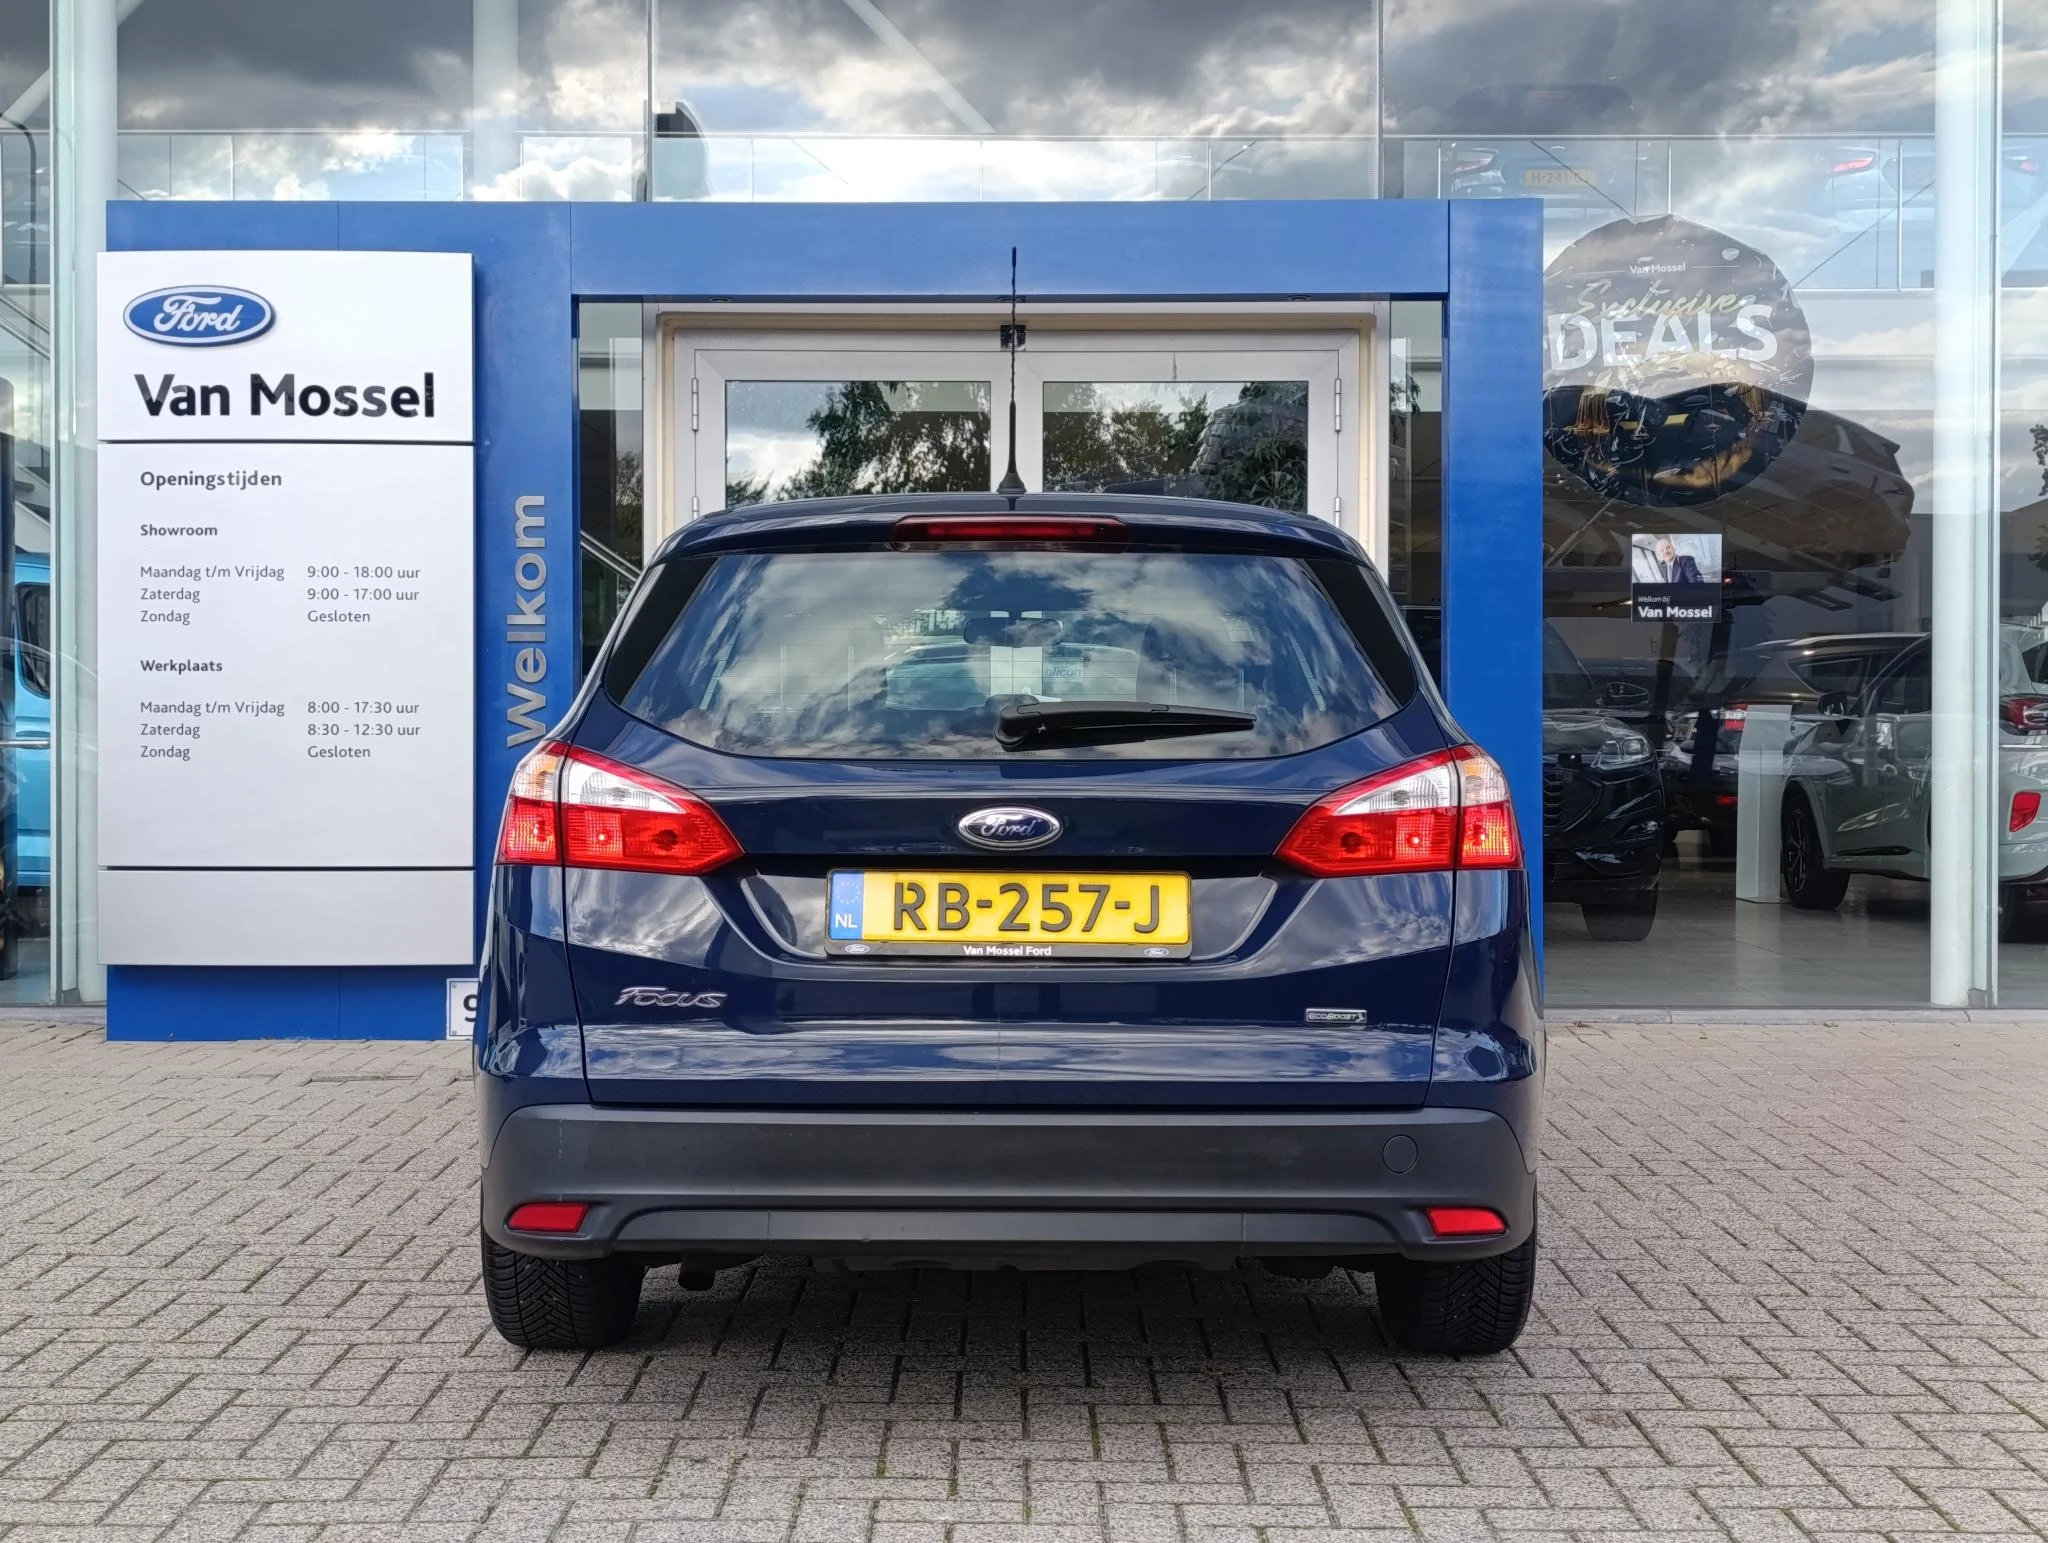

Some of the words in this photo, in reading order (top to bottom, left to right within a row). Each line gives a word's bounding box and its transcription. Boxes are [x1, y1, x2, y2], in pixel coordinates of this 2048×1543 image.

[153, 294, 243, 333] Ford
[1547, 304, 1778, 371] DEALS
[134, 373, 231, 418] Van
[250, 371, 436, 419] Mossel
[140, 469, 282, 491] Openingstijden
[140, 523, 218, 537] Showroom
[140, 564, 202, 582] Maandag
[205, 564, 231, 579] t/m
[234, 564, 285, 582] Vrijdag
[307, 565, 340, 579] 9:00
[353, 565, 394, 579] 18:00
[397, 569, 421, 579] uur
[140, 586, 201, 604] Zaterdag
[307, 587, 340, 601] 9:00
[353, 587, 393, 601] 17:00
[396, 591, 420, 601] uur
[140, 608, 191, 626] Zondag
[307, 609, 371, 623] Gesloten
[1638, 605, 1663, 618] Van
[1666, 605, 1713, 618] Mossel
[506, 494, 548, 748] Welkom
[140, 658, 224, 676] Werkplaats
[140, 700, 202, 718] Maandag
[205, 700, 231, 715] t/m
[234, 700, 286, 718] Vrijdag
[307, 700, 340, 714] 8:00
[353, 701, 393, 714] 17:30
[396, 704, 420, 714] uur
[140, 722, 201, 740] Zaterdag
[307, 723, 340, 736] 8:30
[353, 723, 394, 736] 12:30
[397, 726, 421, 736] uur
[140, 744, 192, 762] Zondag
[307, 744, 371, 759] Gesloten
[981, 815, 1037, 837] Ford
[893, 881, 1161, 935] RB-257-J
[835, 914, 858, 929] NL
[963, 945, 983, 956] Van
[986, 945, 1023, 956] Mossel
[1026, 946, 1052, 957] Ford
